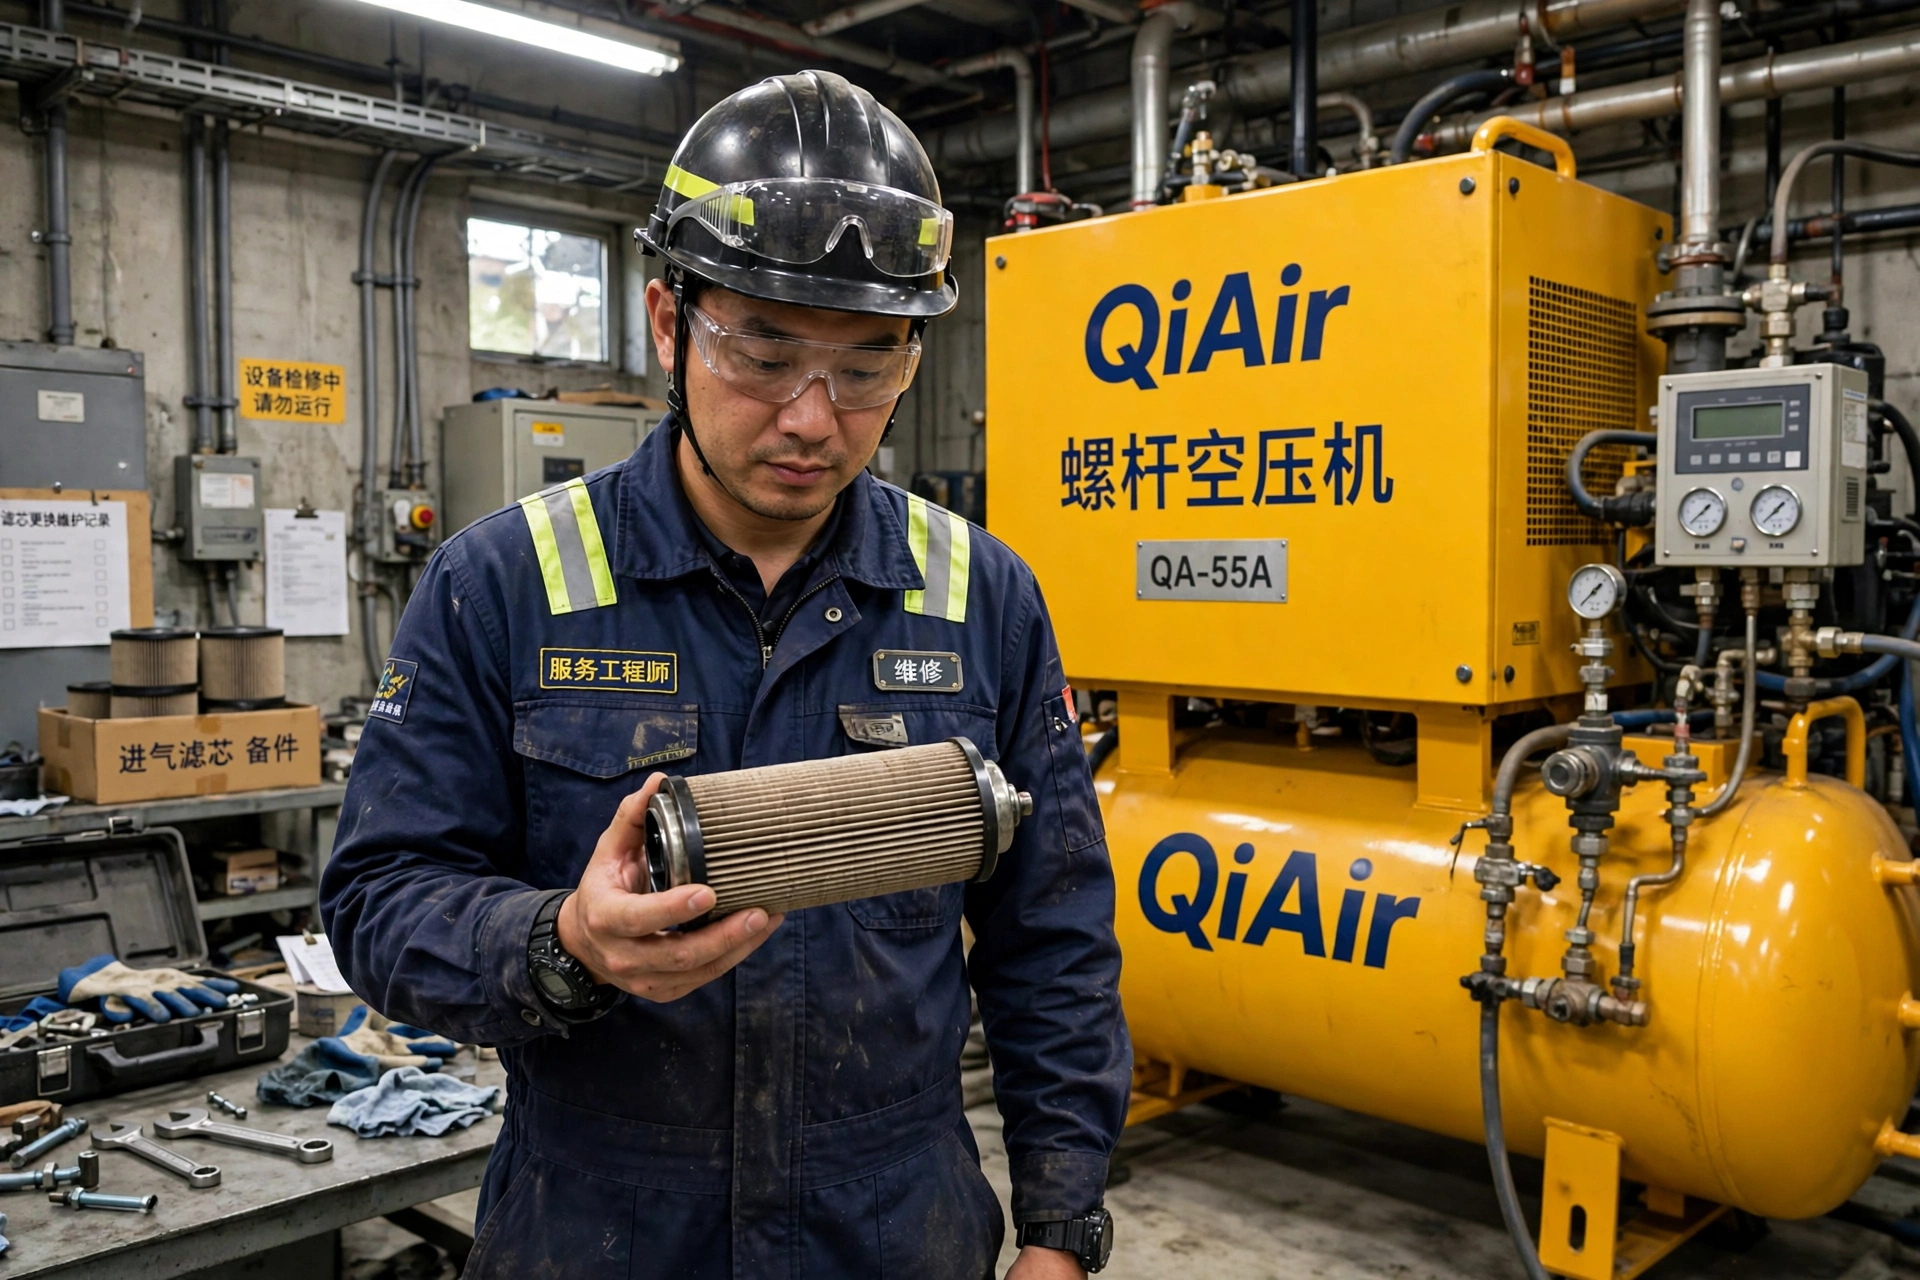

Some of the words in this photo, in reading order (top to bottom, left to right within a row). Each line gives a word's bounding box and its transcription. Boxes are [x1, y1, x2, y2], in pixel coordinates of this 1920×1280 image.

[1084, 263, 1351, 391] QiAir
[245, 366, 340, 392] 设备检修中
[254, 392, 331, 417] 请勿运行
[1061, 421, 1394, 511] 螺杆空压机
[1150, 555, 1273, 590] QA-55A
[549, 657, 671, 684] 服务工程师
[894, 659, 943, 684] 维修
[119, 739, 233, 774] 进气滤芯
[246, 733, 299, 764] 备件
[1138, 832, 1422, 969] QiAir
